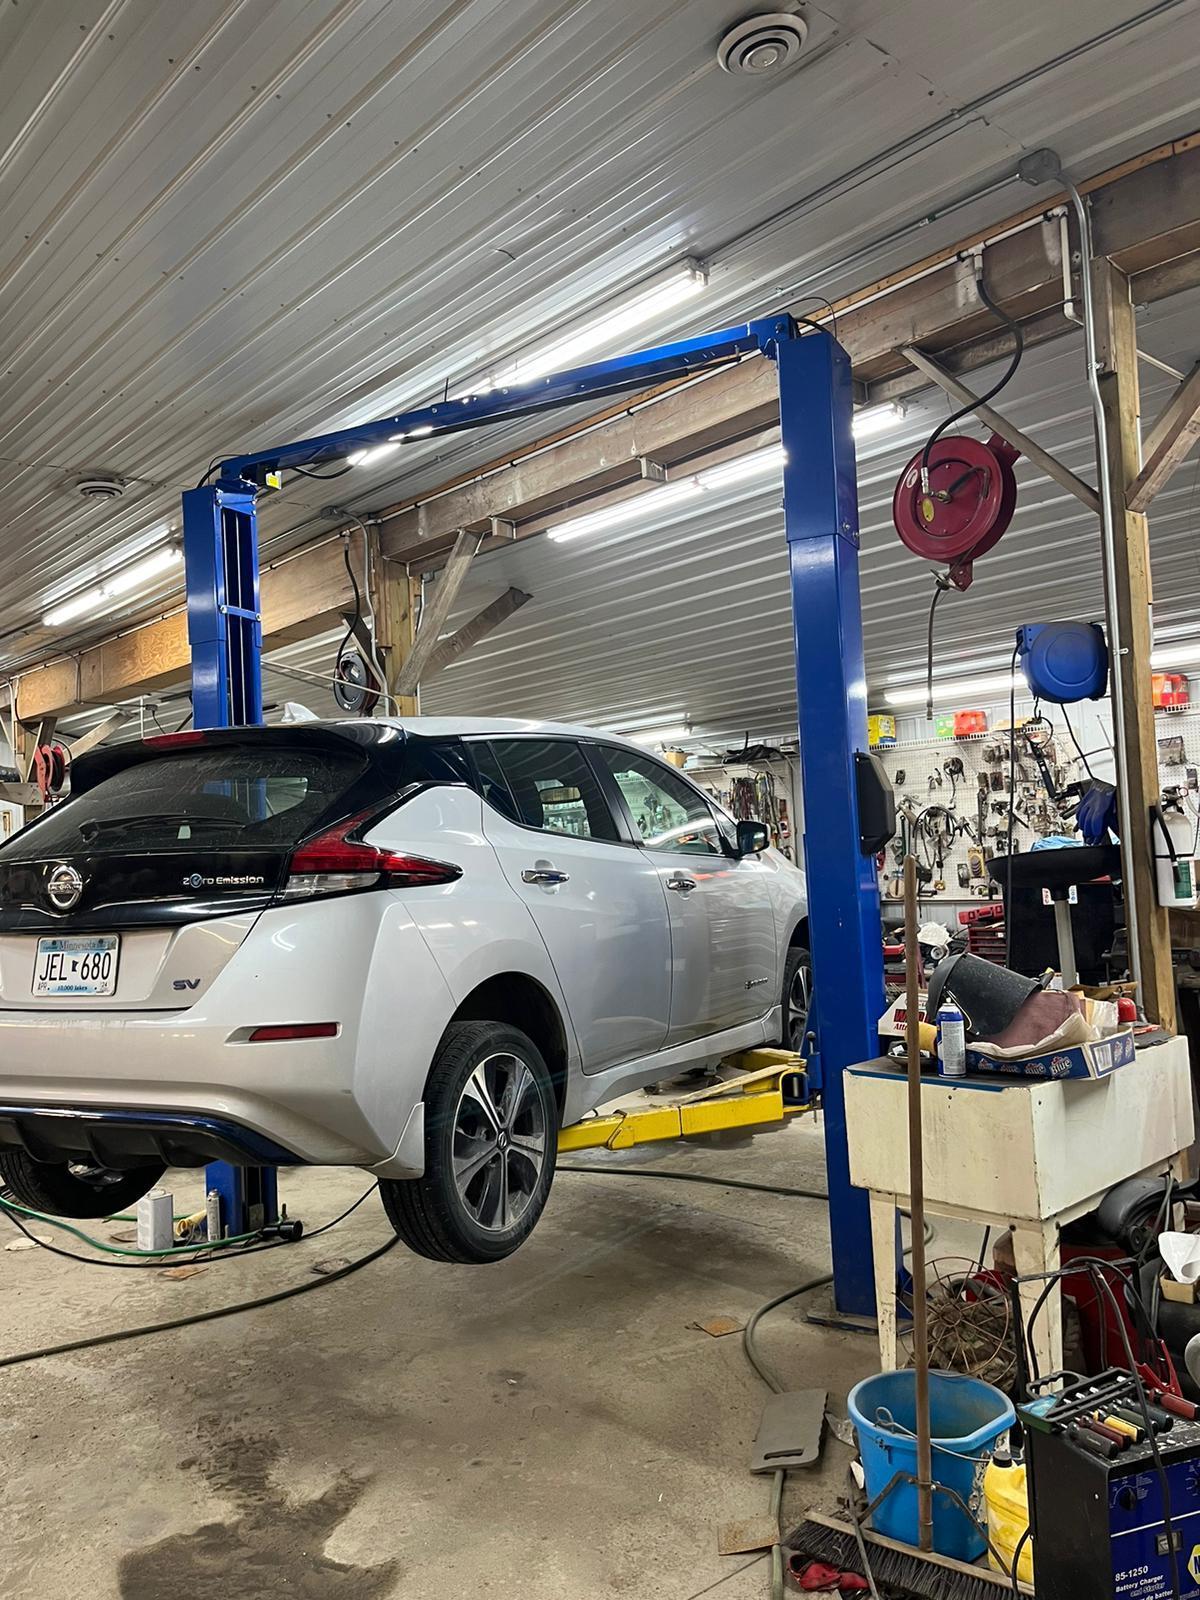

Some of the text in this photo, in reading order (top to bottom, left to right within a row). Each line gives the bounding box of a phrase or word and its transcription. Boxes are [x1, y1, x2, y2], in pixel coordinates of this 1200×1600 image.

[216, 876, 264, 885] Emission
[40, 952, 111, 981] JEL 680
[173, 979, 200, 991] SV
[1050, 1059, 1072, 1076] Blue
[1115, 1565, 1149, 1582] 85-1250
[1115, 1574, 1164, 1593] Battery Charger
